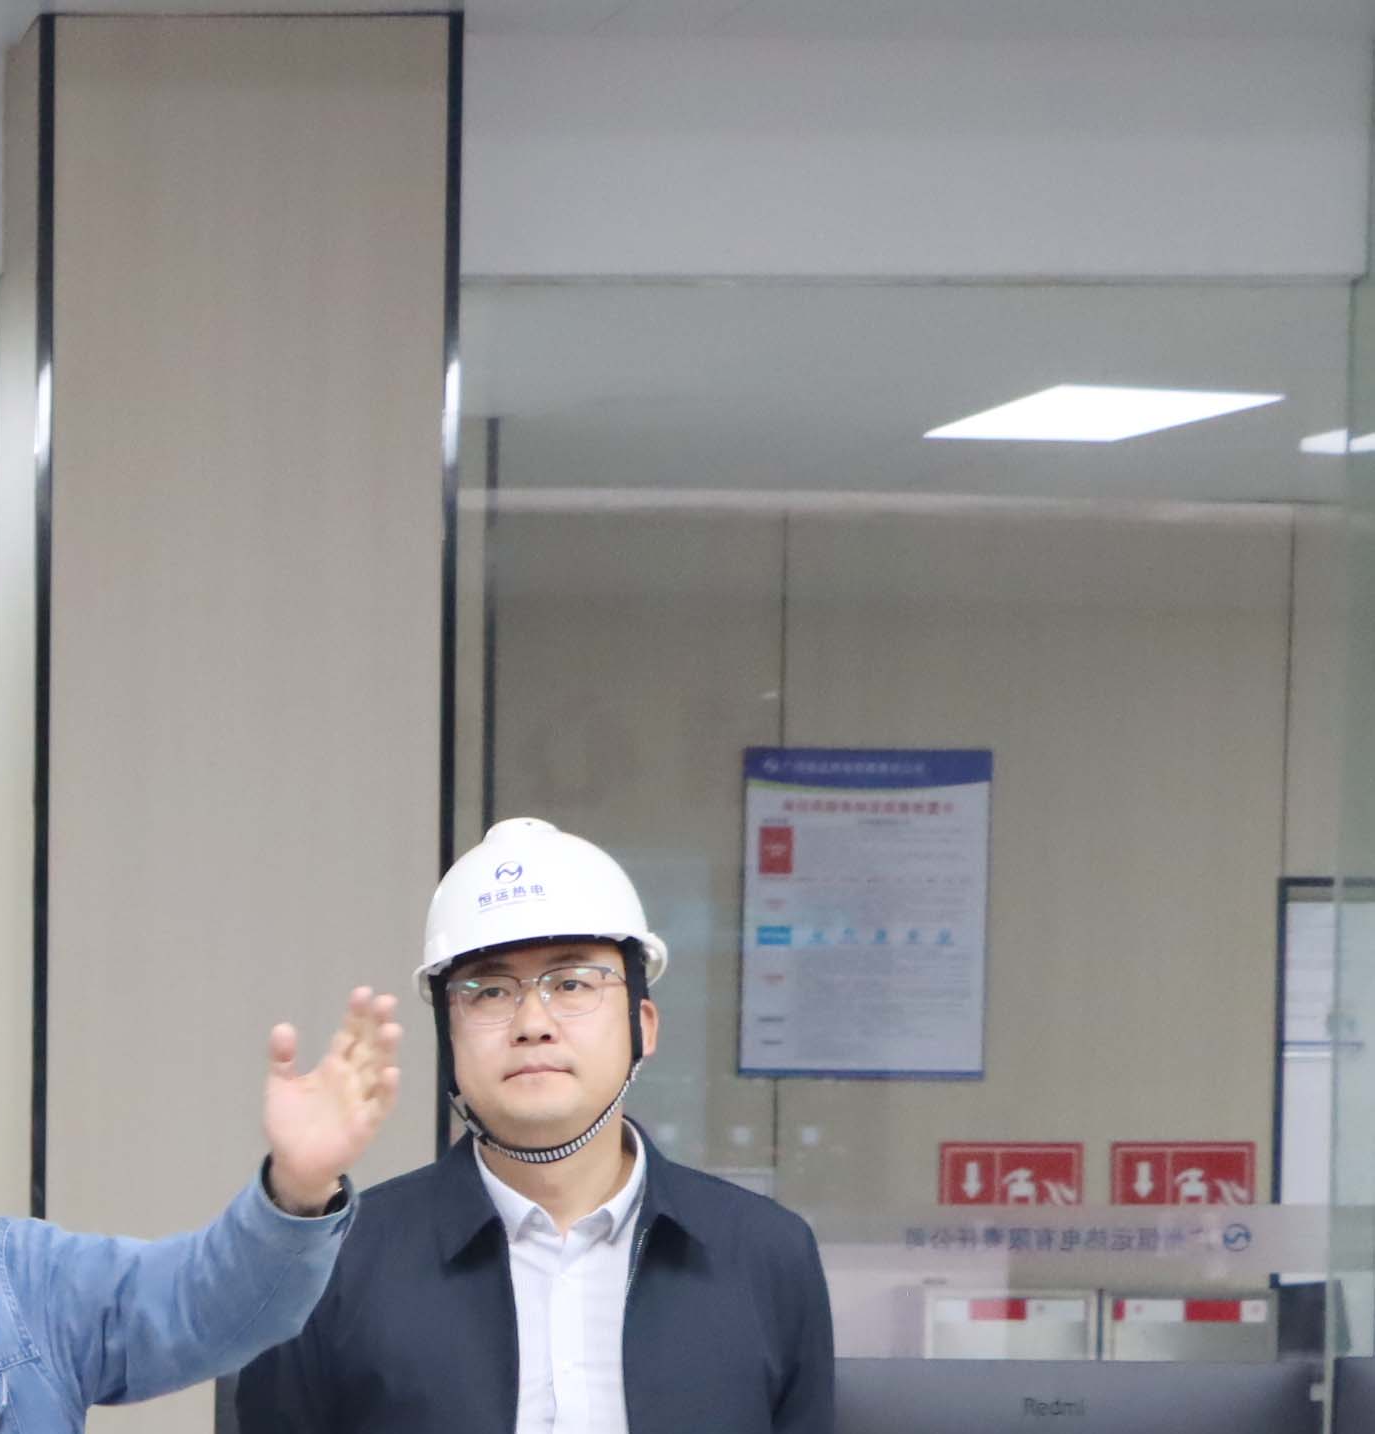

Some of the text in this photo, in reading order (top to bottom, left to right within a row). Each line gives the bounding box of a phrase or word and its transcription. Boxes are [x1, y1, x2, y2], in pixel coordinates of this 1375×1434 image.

[478, 884, 546, 907] 恒运热电
[1023, 1396, 1086, 1417] Redmi
